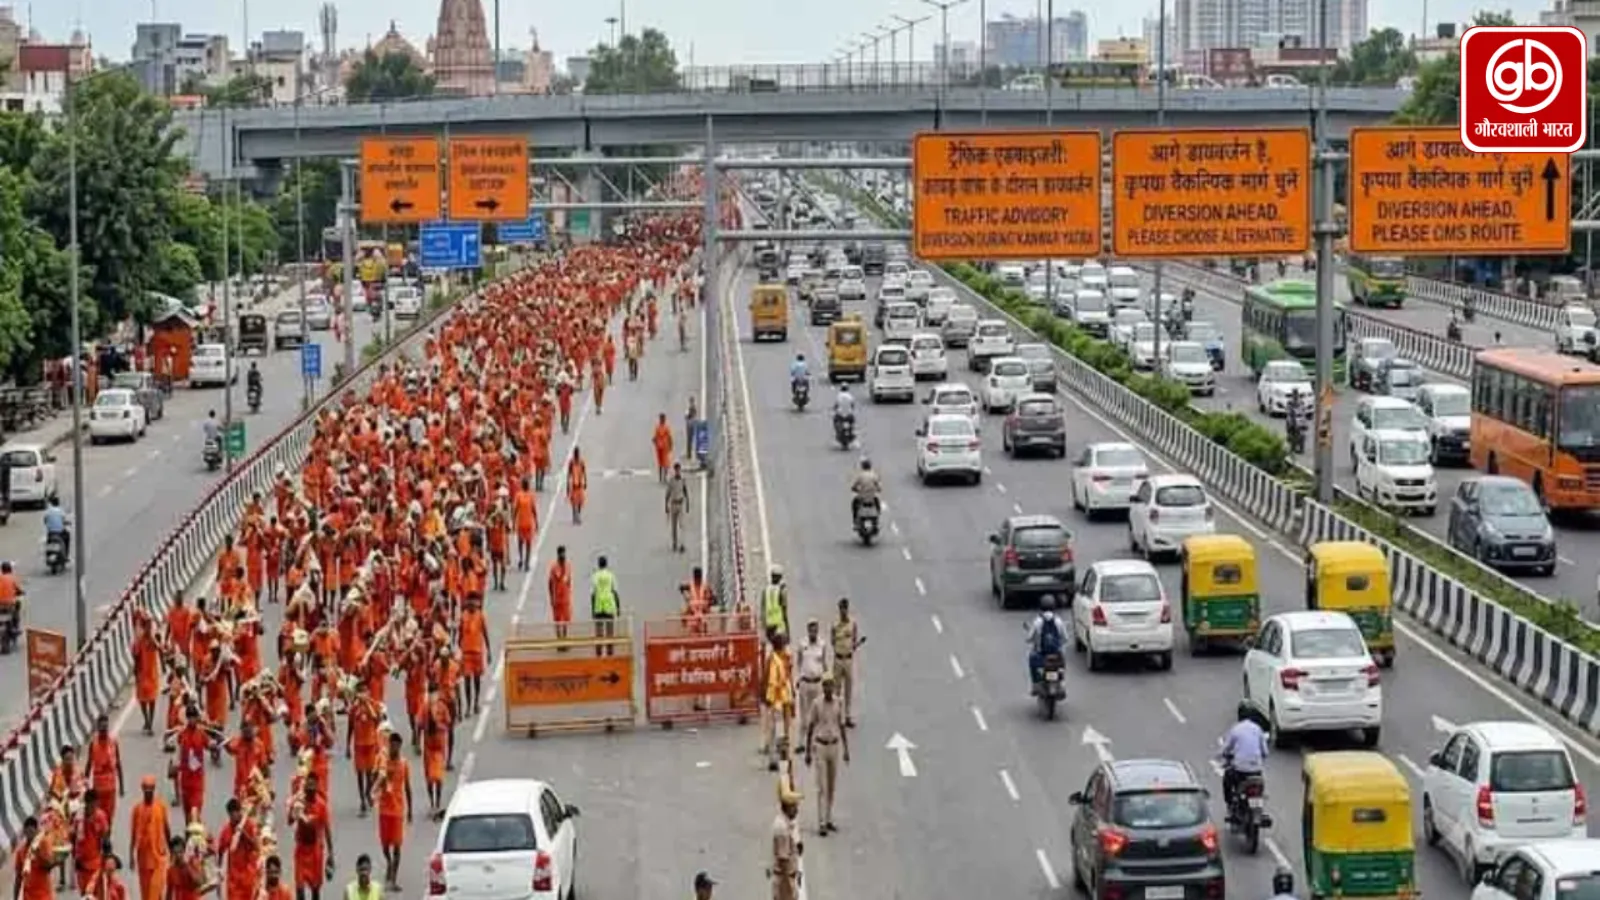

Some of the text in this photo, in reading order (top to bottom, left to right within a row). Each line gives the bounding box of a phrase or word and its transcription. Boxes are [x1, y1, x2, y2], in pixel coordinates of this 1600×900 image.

[1150, 138, 1181, 163] आगे
[944, 206, 1068, 225] TRAFFIC ADVISORY
[1143, 204, 1223, 221] DIVERSION
[1378, 201, 1458, 219] DIVERSION
[1127, 227, 1171, 246] PLEASE
[1173, 228, 1218, 245] CHOOSE
[1371, 224, 1429, 243] PLEASE
